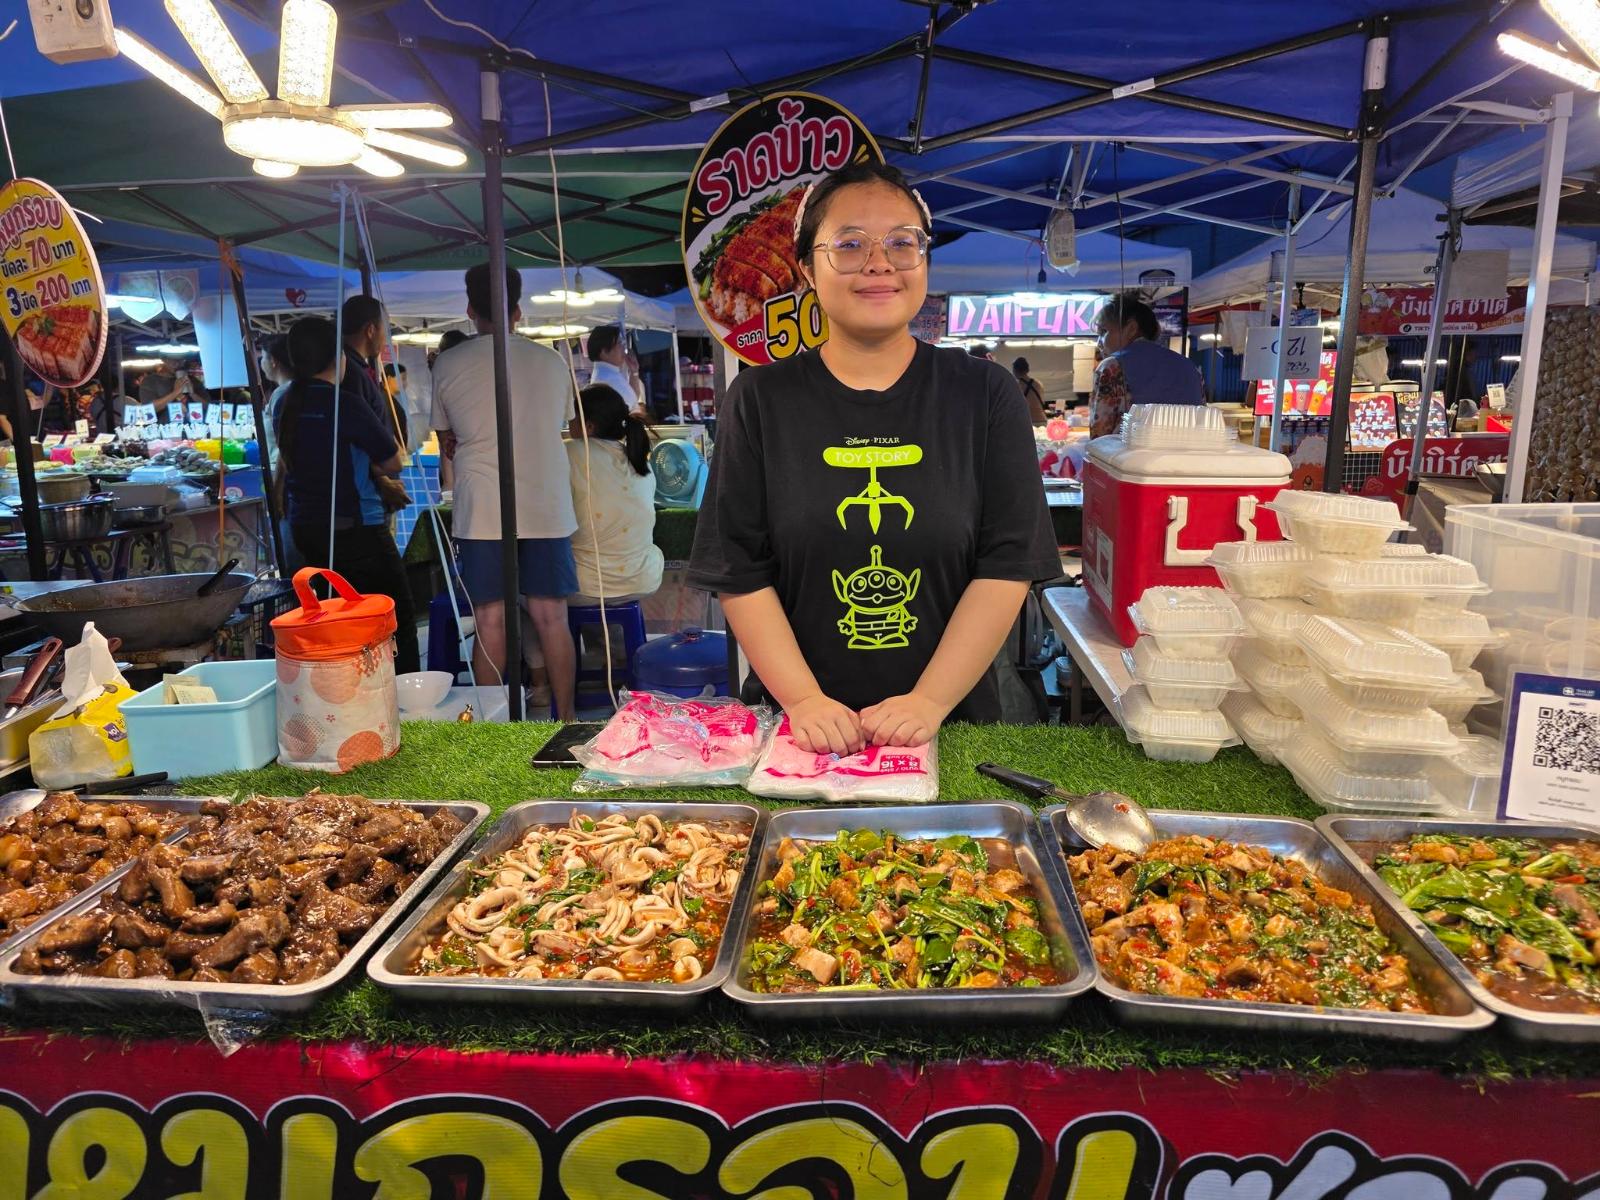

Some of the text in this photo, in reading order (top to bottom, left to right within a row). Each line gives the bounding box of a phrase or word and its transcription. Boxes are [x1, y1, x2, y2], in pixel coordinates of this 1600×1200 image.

[698, 99, 853, 215] ราดข้าว
[25, 236, 50, 267] 70
[53, 239, 76, 260] บาท
[6, 273, 91, 317] 3 ขีด 200 บาท
[737, 291, 830, 360] ราคา 50
[835, 450, 911, 463] TOY STORY
[844, 437, 870, 445] Disney
[881, 761, 894, 769] 16
